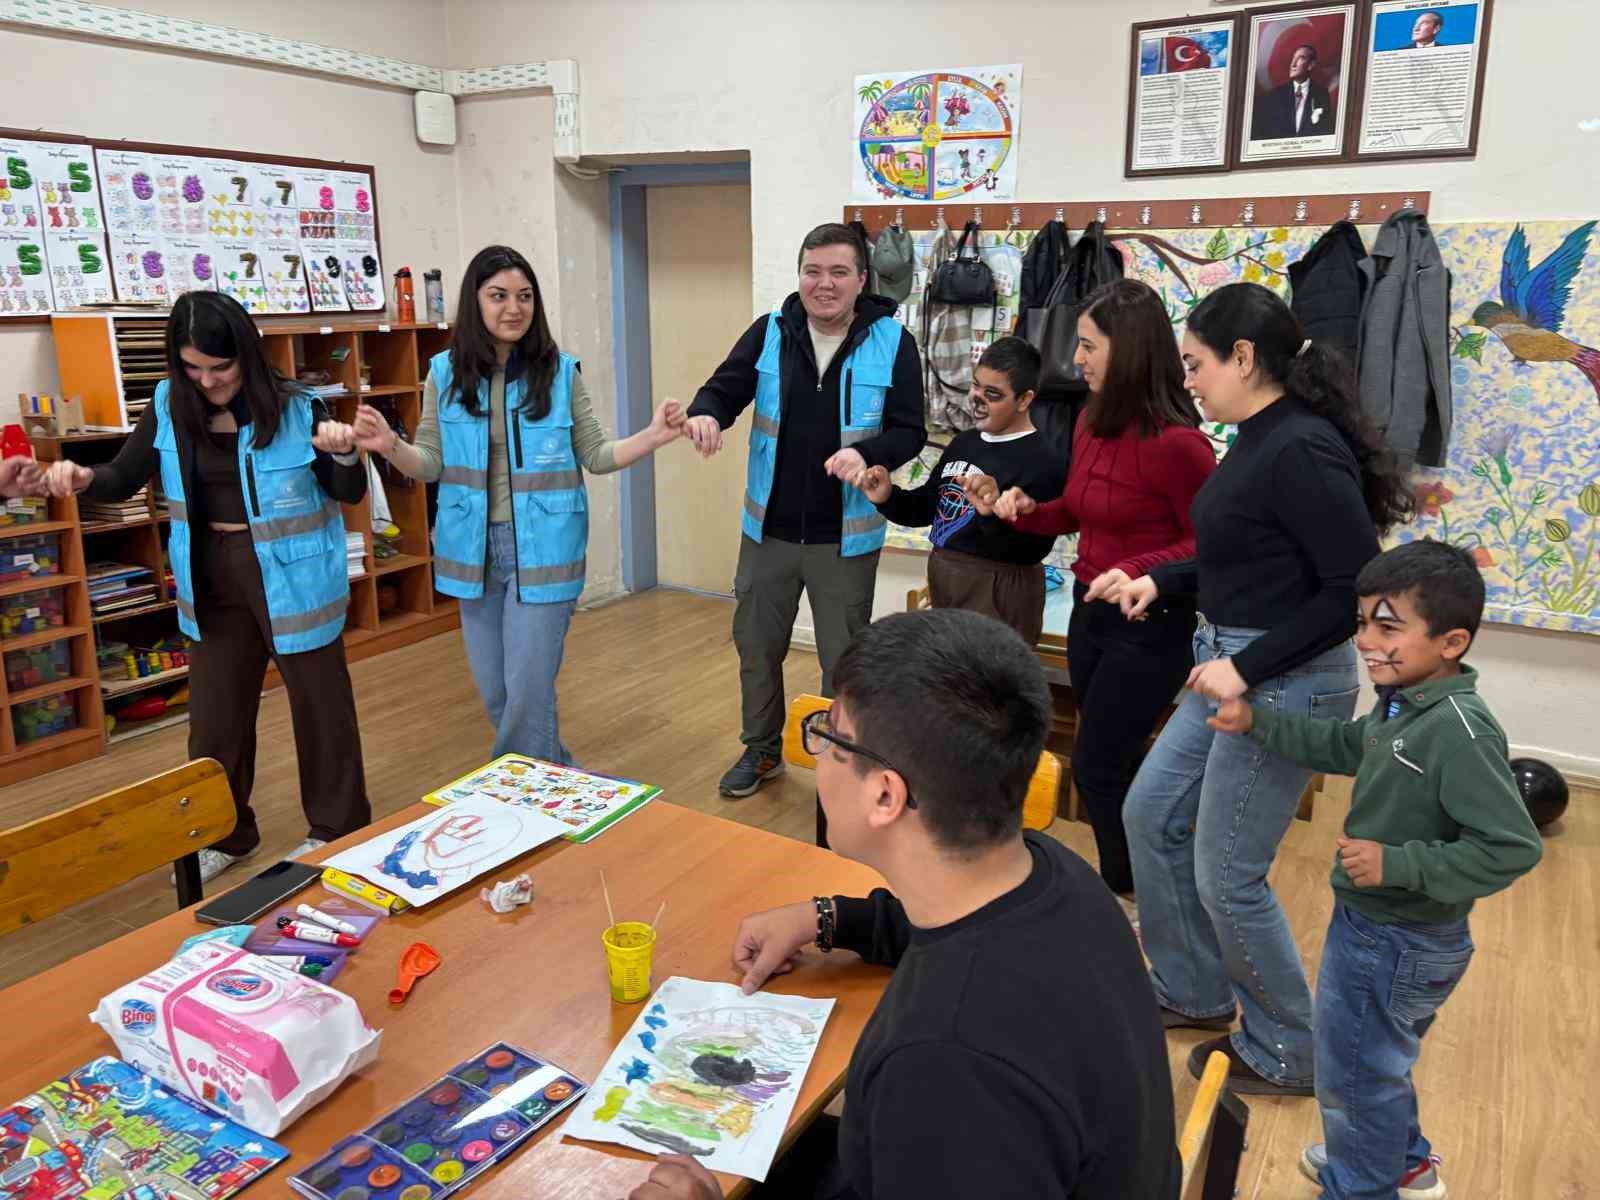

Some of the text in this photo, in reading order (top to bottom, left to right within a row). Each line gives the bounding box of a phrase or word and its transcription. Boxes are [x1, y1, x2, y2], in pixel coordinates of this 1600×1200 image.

[7, 157, 33, 190] 5
[68, 162, 92, 192] 5
[131, 172, 154, 201] 6
[182, 174, 204, 203] 6
[231, 176, 248, 202] 7
[275, 180, 293, 206] 7
[319, 185, 335, 210] 8
[355, 188, 370, 213] 8
[17, 244, 42, 275] 5
[78, 243, 103, 274] 5
[142, 250, 165, 279] 6
[193, 253, 212, 281] 6
[239, 252, 257, 278] 7
[283, 254, 301, 280] 7
